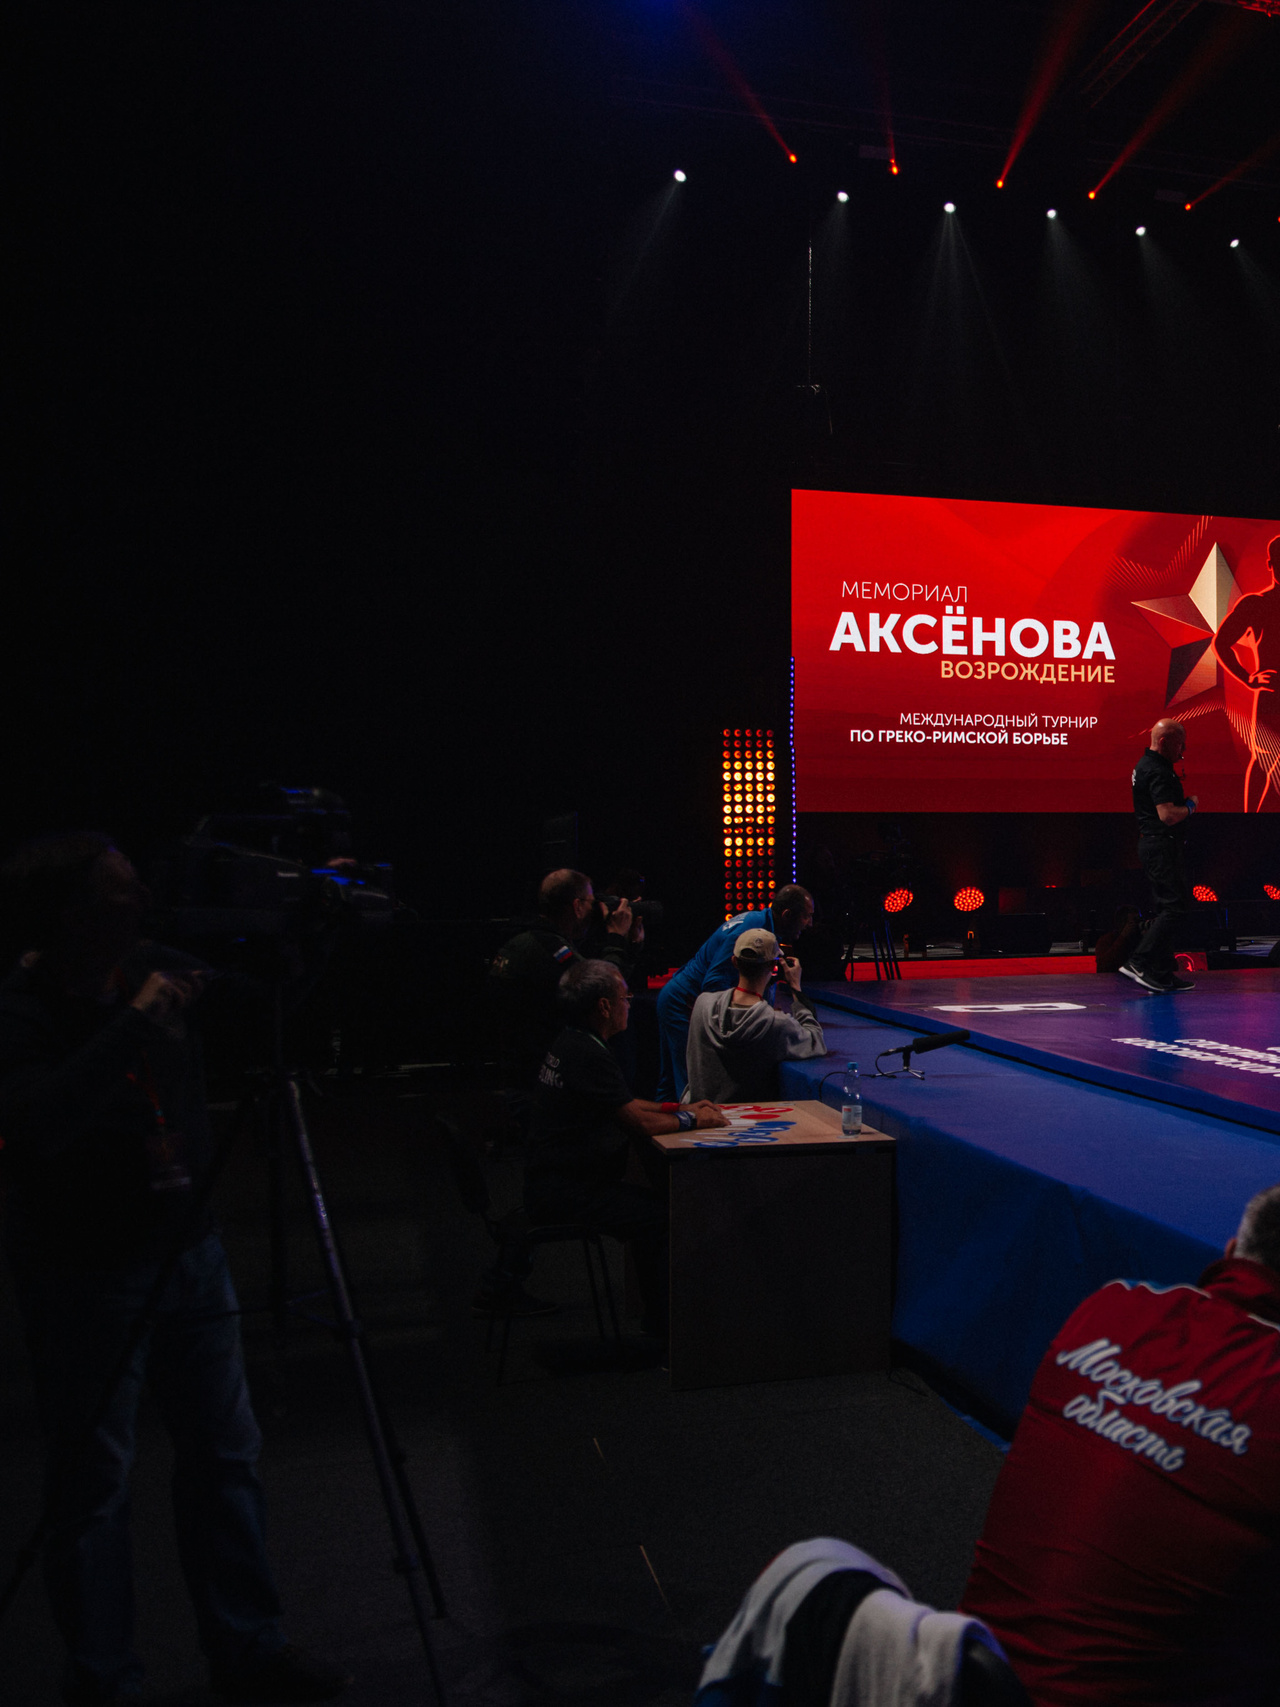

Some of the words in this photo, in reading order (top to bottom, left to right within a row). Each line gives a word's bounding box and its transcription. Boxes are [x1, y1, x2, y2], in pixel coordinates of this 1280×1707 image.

[841, 580, 968, 603] МЕМОРИАЛ
[829, 605, 1116, 660] АКСЁНОВА
[940, 661, 1116, 684] ВОЗРОЖДЕНИЕ
[899, 712, 1038, 728] МЕЖДУНАРОДНЫЙ
[1042, 715, 1098, 729] ТУРНИР
[850, 730, 874, 742] ПО
[878, 730, 1009, 744] ГРЕКО-РИМСКОЙ
[1013, 732, 1068, 745] БОРЬБЕ
[1056, 1337, 1252, 1455] Московская
[1063, 1388, 1186, 1472] область
